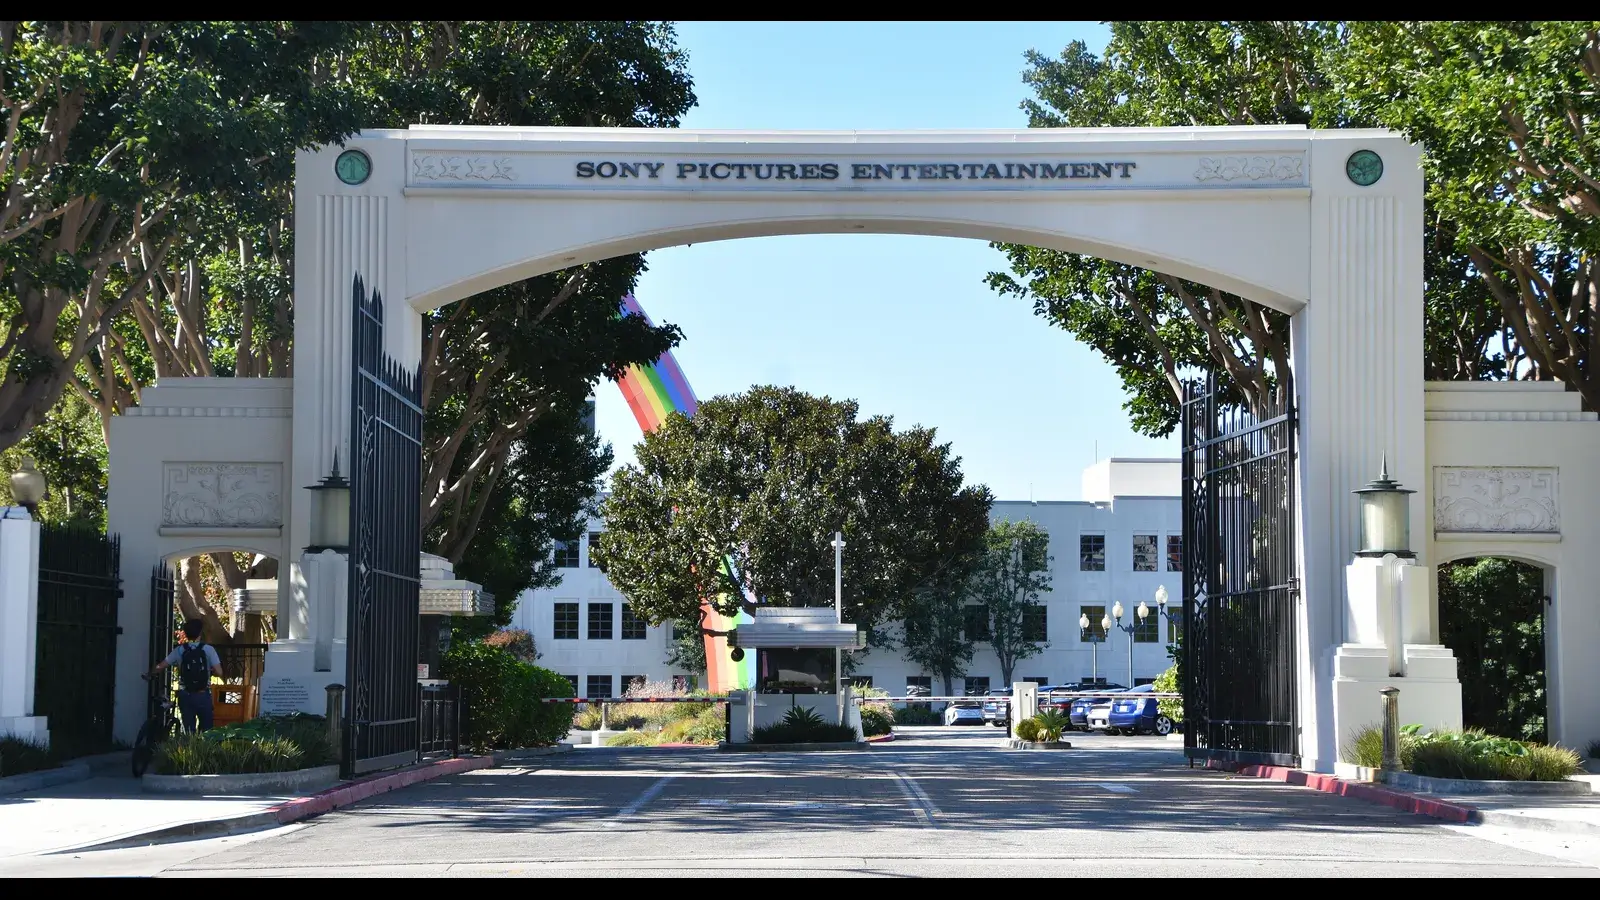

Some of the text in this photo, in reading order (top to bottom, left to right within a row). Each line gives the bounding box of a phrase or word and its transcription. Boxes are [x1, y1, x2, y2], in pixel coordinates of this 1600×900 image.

[576, 162, 1137, 180] SONY PICTURES ENTERTAINMENT
